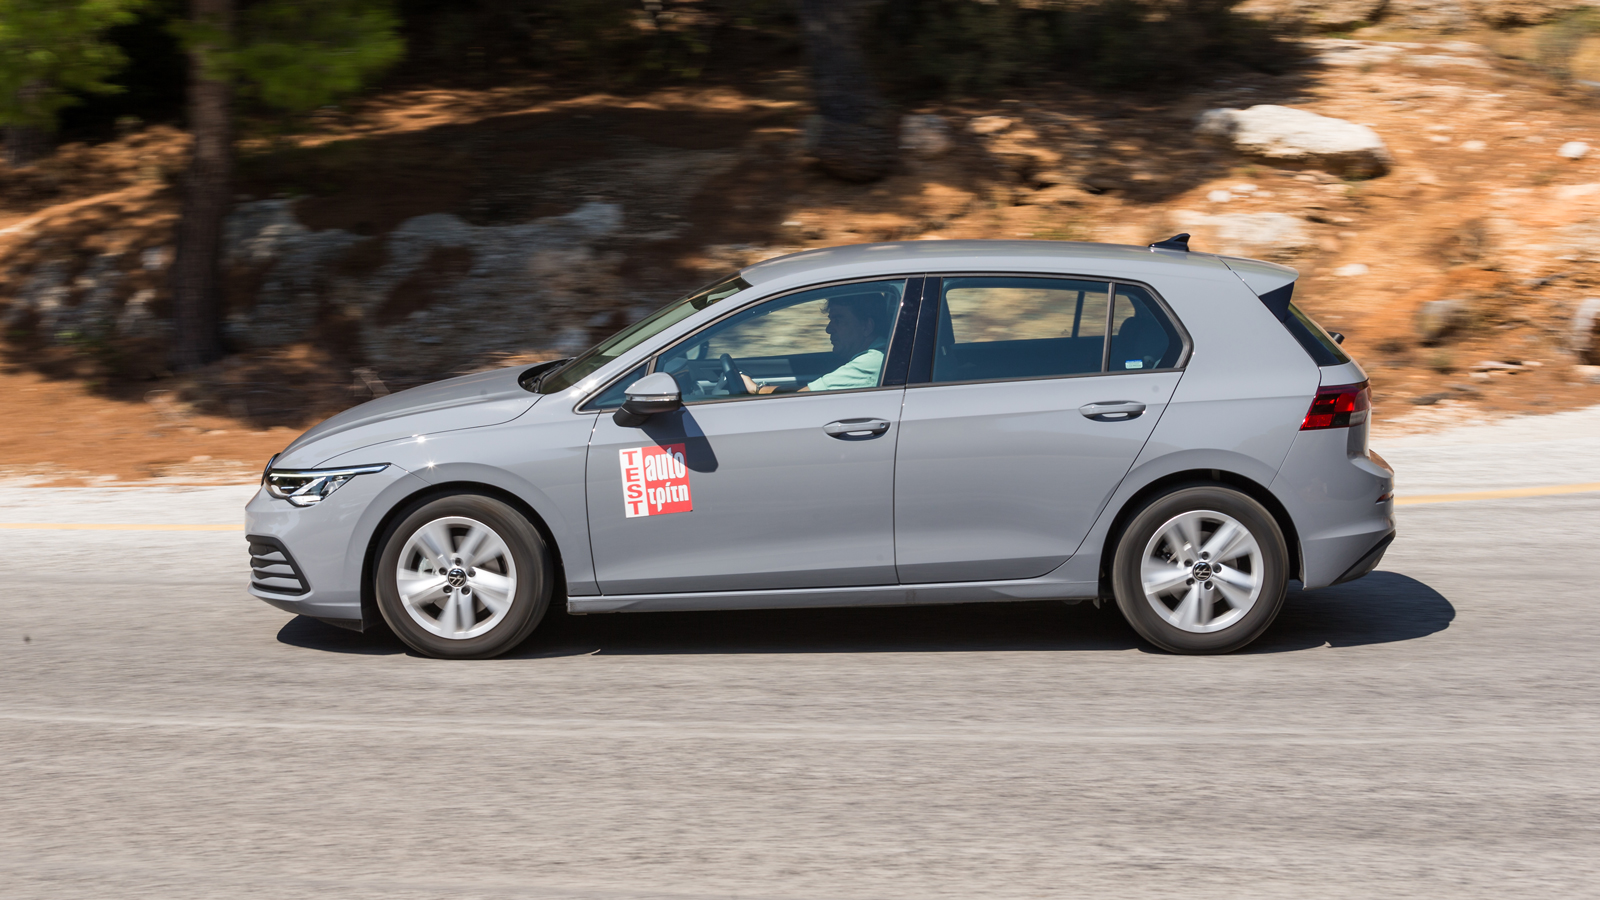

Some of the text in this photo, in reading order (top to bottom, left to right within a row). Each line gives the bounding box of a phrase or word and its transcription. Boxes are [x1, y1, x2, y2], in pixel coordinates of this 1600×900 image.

[644, 447, 686, 482] auto
[622, 450, 643, 515] TEST
[647, 481, 689, 512] τρίτη
